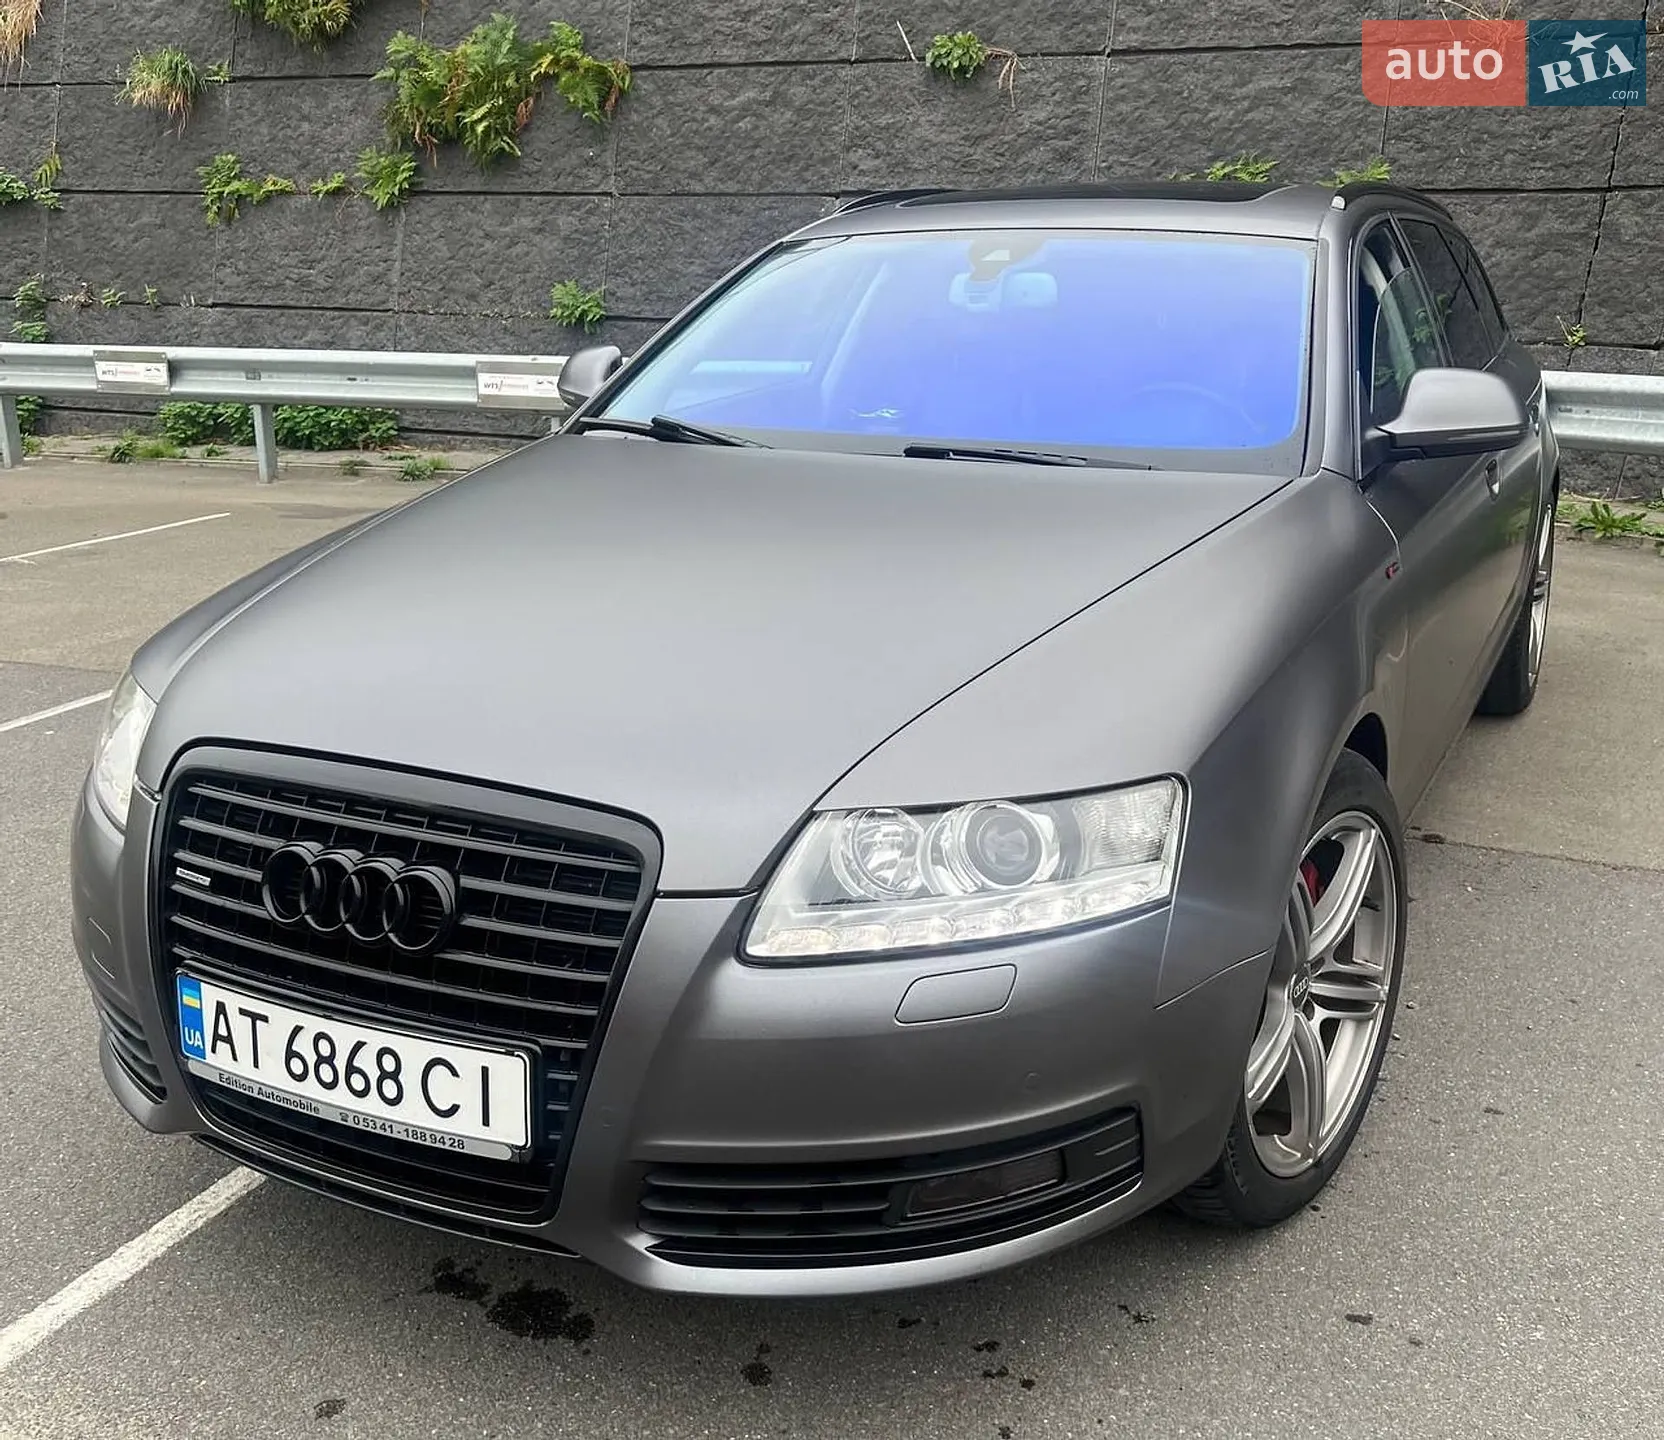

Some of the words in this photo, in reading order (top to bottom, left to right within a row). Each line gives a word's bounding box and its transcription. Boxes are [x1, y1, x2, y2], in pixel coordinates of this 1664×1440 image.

[185, 1027, 203, 1049] UA
[210, 1000, 269, 1070] AT
[284, 1025, 404, 1106] 6868
[421, 1057, 490, 1127] CI
[218, 1072, 254, 1094] Edition
[257, 1086, 321, 1115] Automobile
